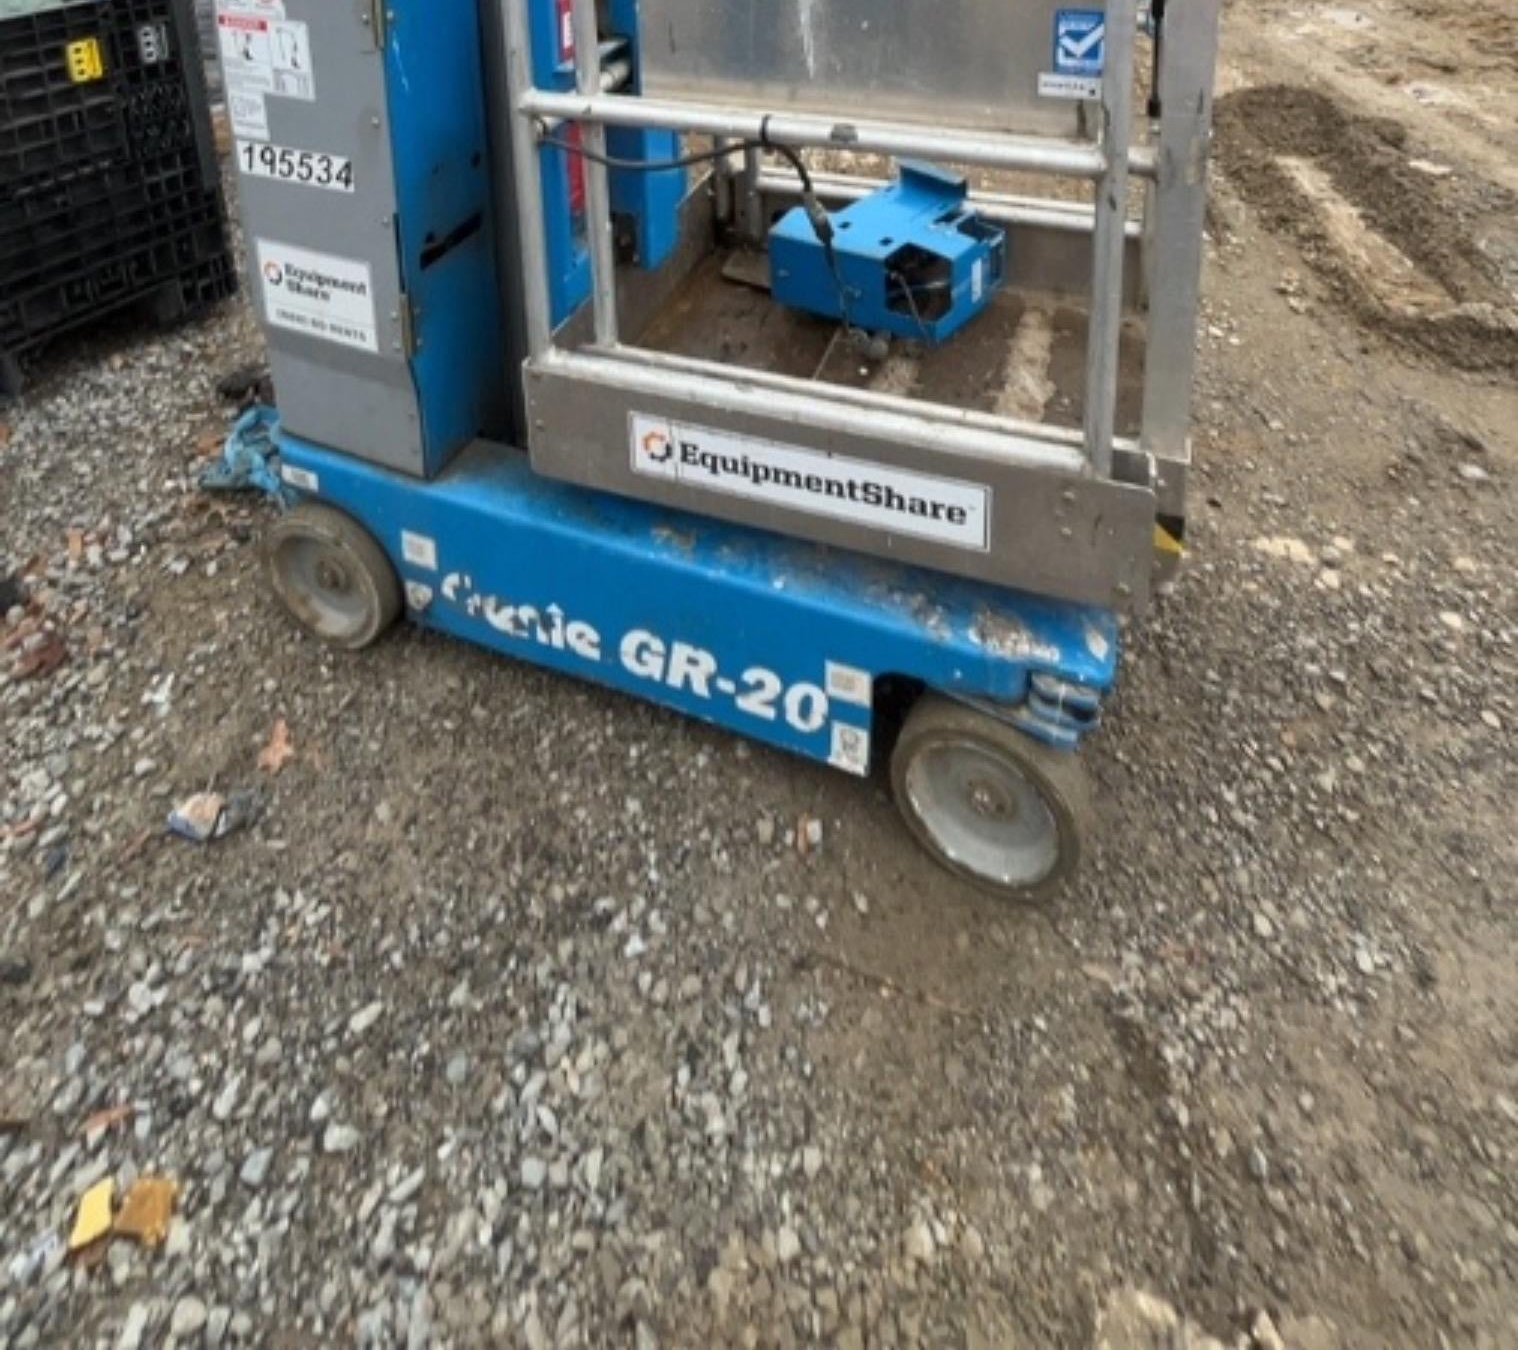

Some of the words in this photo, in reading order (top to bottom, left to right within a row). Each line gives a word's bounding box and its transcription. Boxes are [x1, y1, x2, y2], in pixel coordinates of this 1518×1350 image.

[242, 144, 354, 189] 195534
[679, 441, 967, 525] EquipmentShare
[620, 628, 829, 733] GR-20
